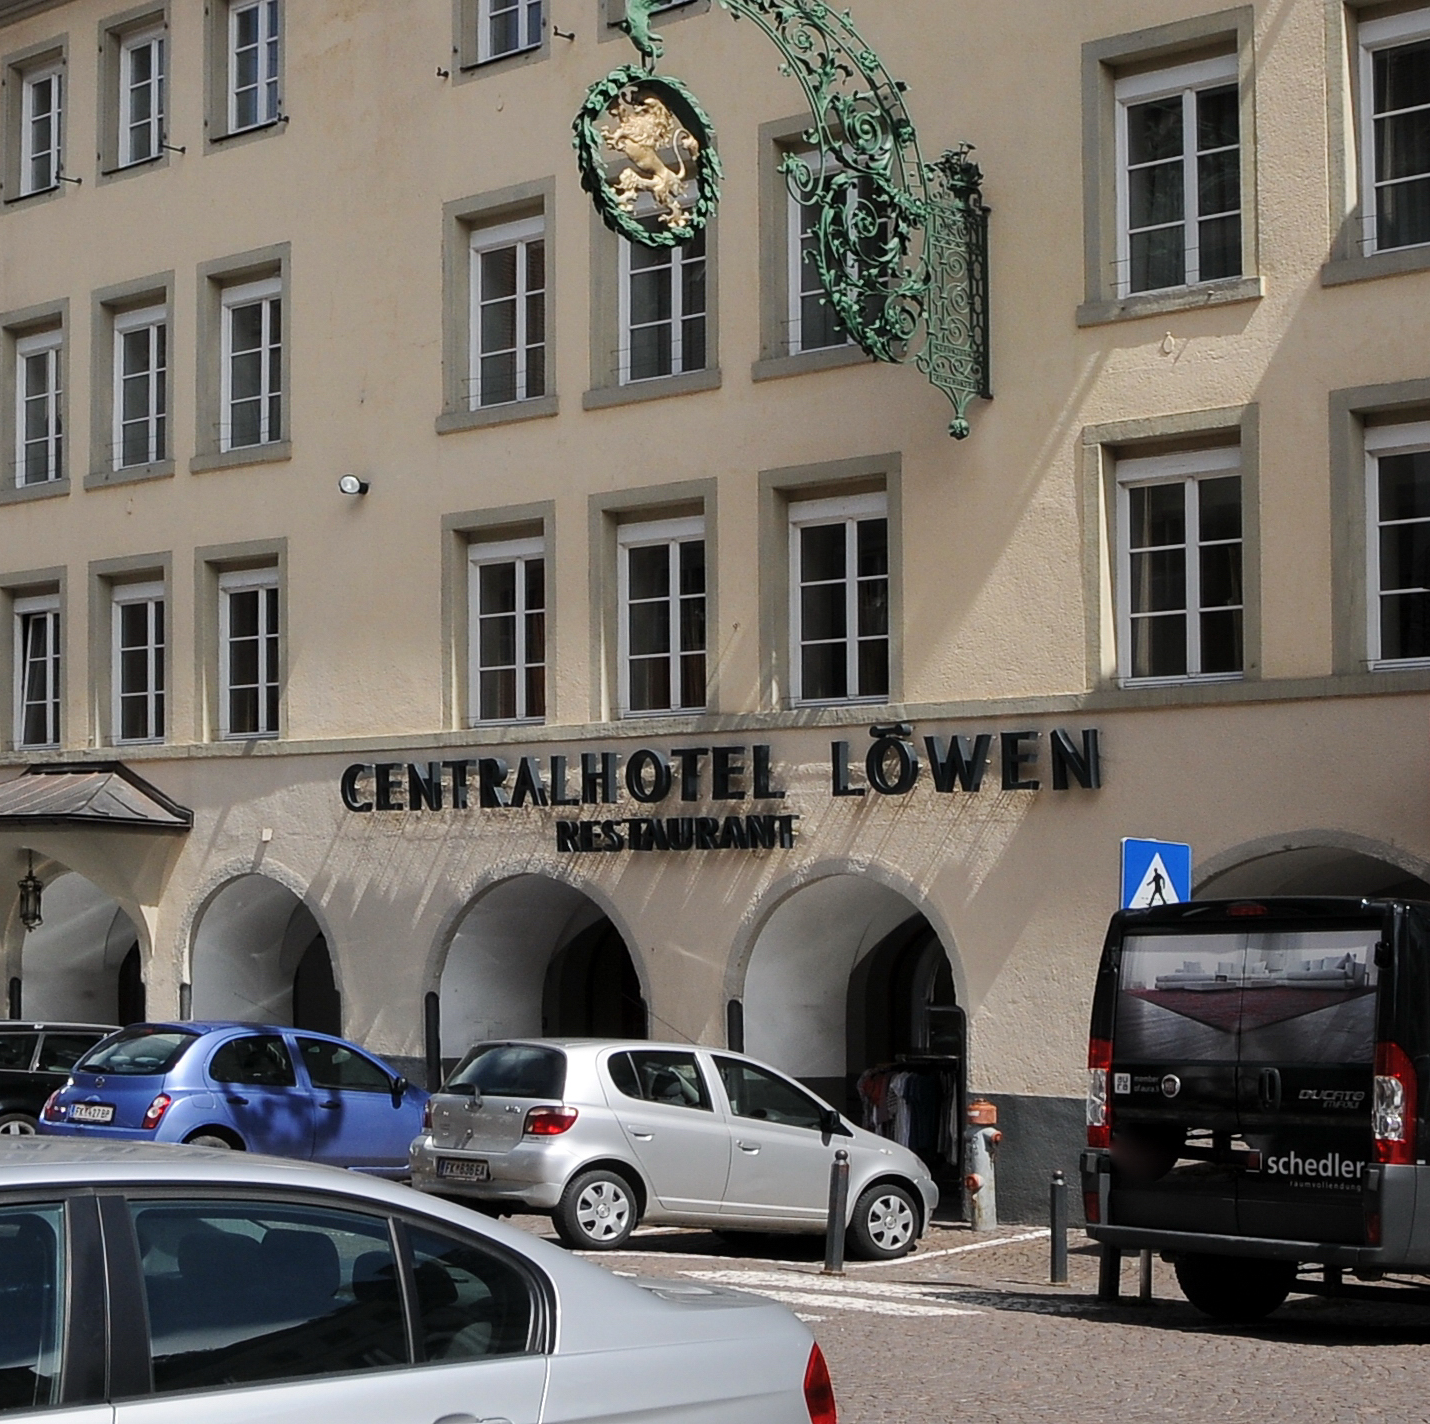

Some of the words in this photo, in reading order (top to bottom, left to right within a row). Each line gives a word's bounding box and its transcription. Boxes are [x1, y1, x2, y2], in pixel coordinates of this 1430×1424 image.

[340, 744, 786, 812] CENTRALHOTEL
[831, 723, 1102, 797] LÖWEN
[556, 814, 800, 853] RESTAURANT
[1298, 1089, 1365, 1101] DUCATO
[1267, 1150, 1365, 1179] schedler
[1289, 1180, 1362, 1192] raumvollendung
